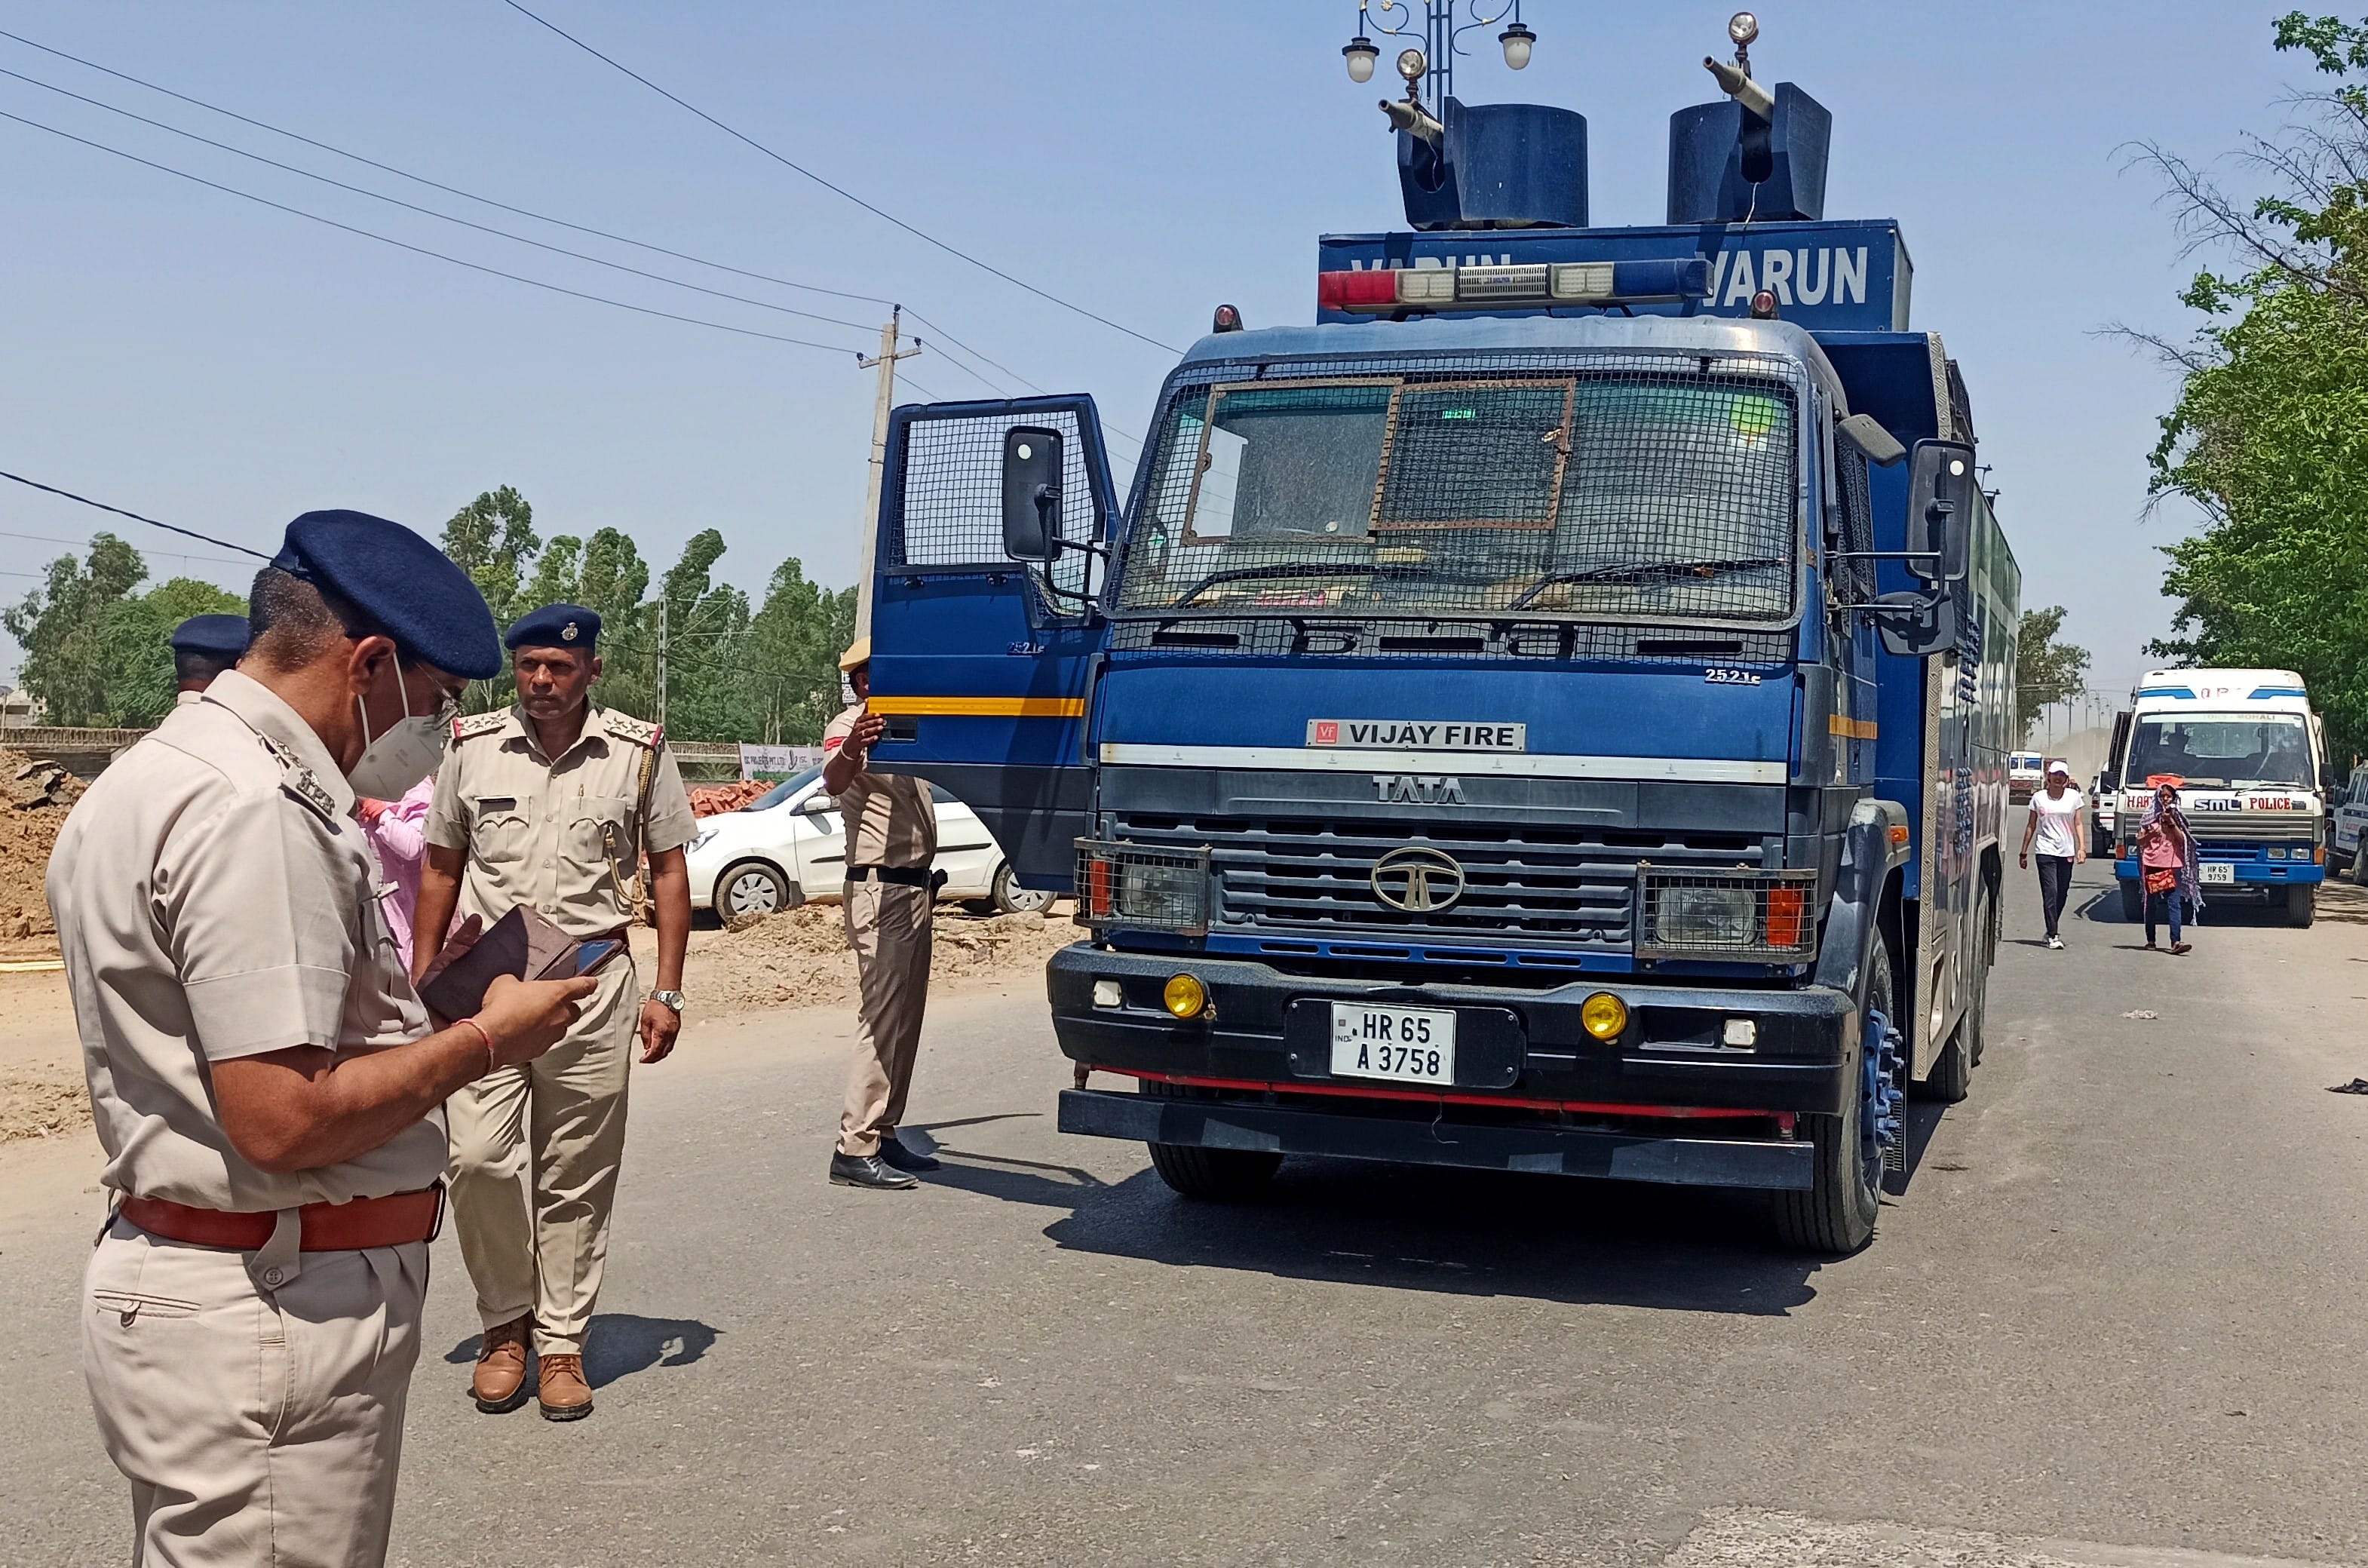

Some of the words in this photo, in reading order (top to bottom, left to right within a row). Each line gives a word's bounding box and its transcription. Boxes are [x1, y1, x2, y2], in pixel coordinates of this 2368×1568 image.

[1695, 247, 1868, 307] VARUN
[1349, 724, 1437, 745] VIJAY
[1445, 726, 1514, 747] FIRE
[1373, 775, 1466, 805] TATA
[2249, 797, 2290, 810] POLICE
[1363, 1013, 1393, 1040] HR
[1400, 1017, 1431, 1043] 65
[1357, 1043, 1370, 1070] A
[1379, 1046, 1440, 1076] 3758
